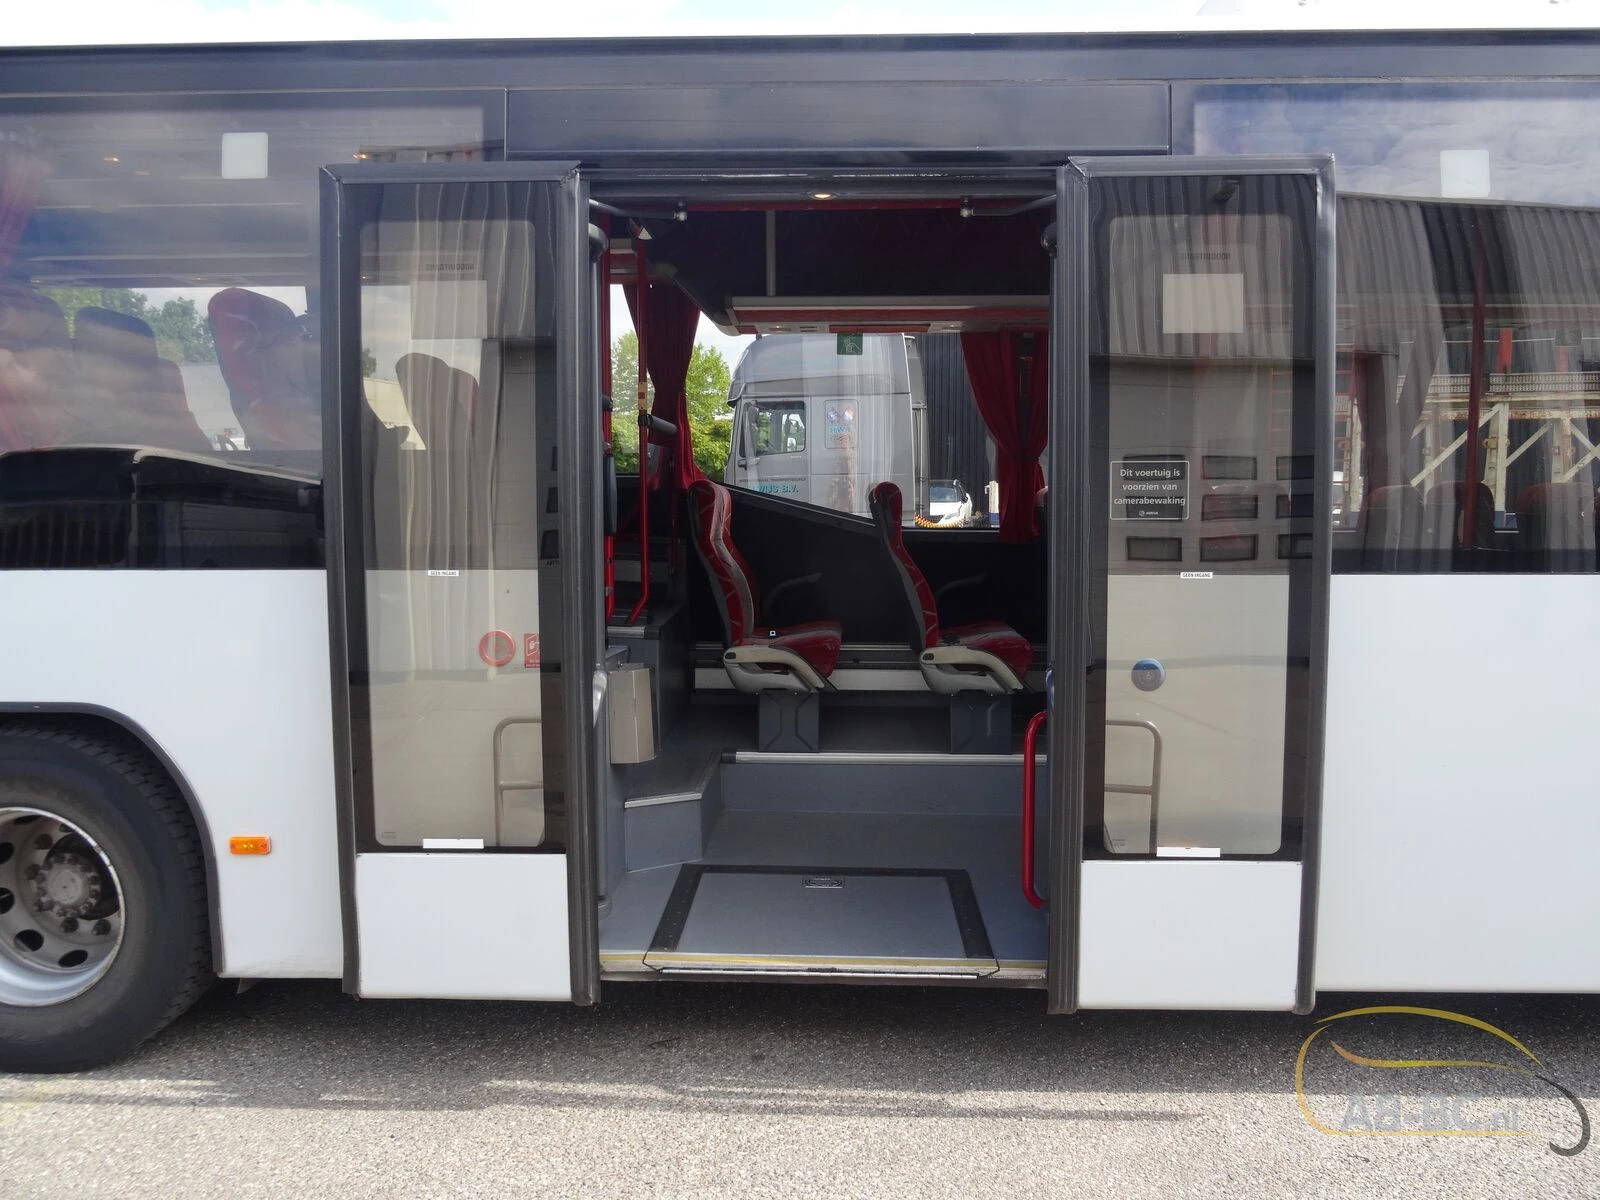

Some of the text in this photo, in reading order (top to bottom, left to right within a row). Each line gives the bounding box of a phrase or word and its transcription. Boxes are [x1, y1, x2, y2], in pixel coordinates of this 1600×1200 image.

[1119, 468, 1181, 479] Dit voertuig is
[781, 483, 799, 493] B.V.
[1122, 482, 1178, 491] voorzien van
[1113, 496, 1186, 506] camerabewaking
